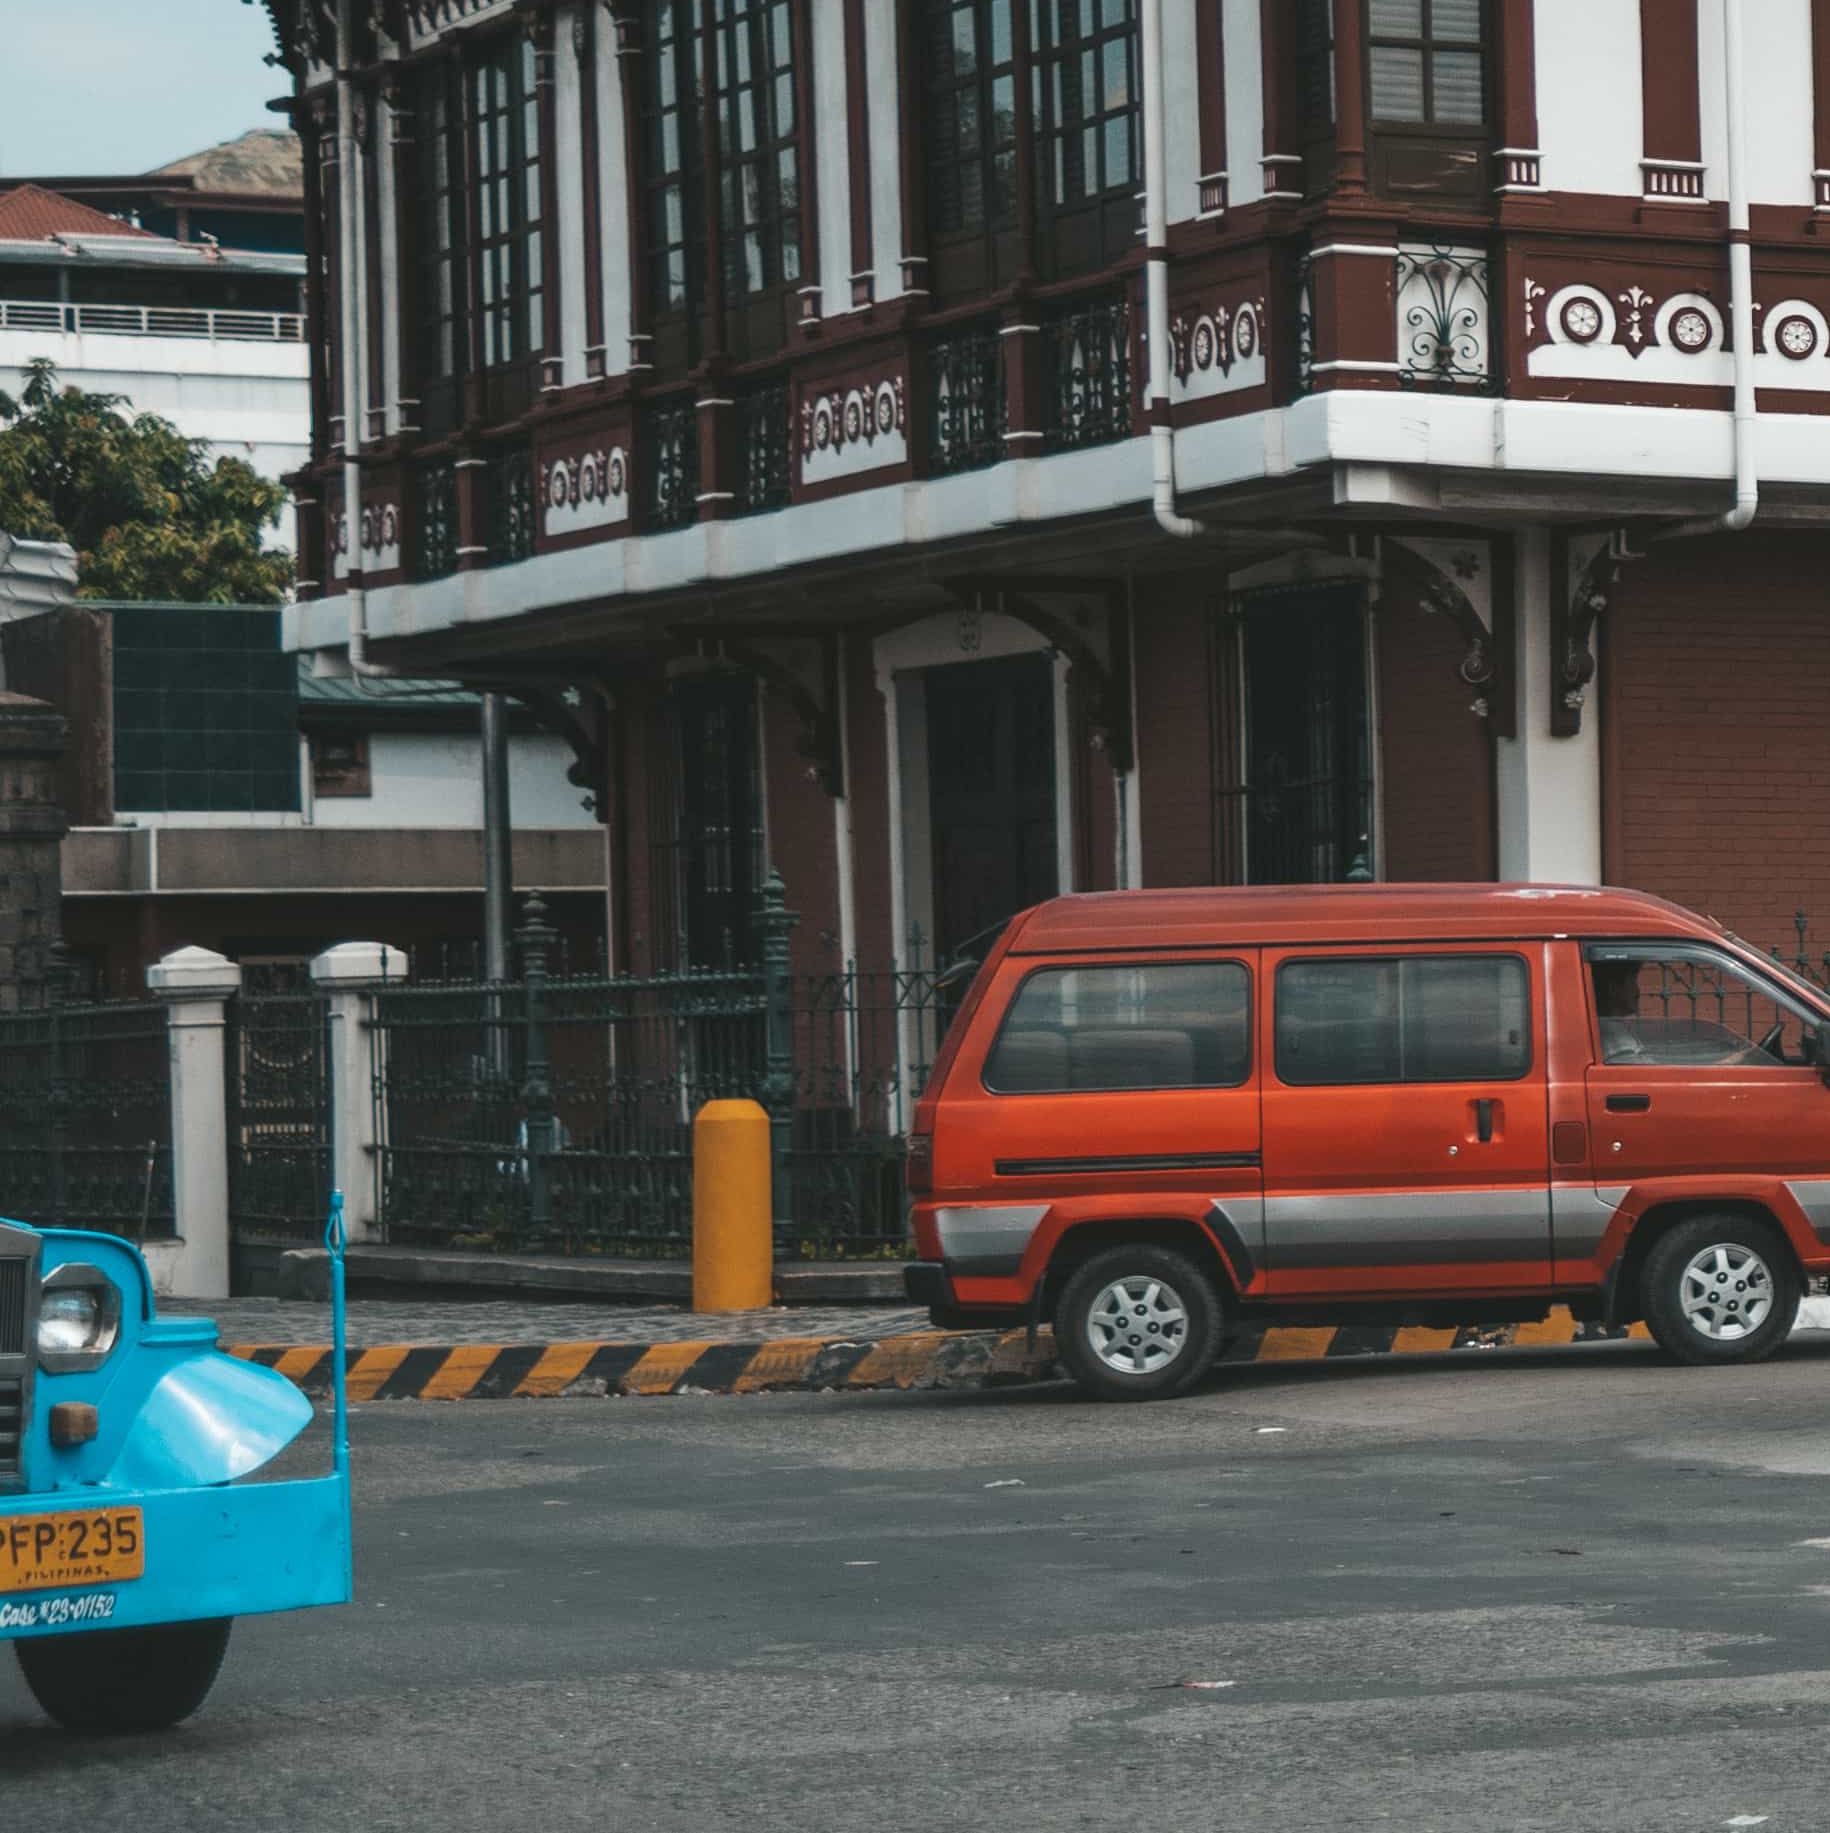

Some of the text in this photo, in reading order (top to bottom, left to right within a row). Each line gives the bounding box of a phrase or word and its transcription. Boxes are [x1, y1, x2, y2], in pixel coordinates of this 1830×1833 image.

[0, 1522, 56, 1567] FP
[67, 1515, 137, 1561] 235
[0, 1601, 38, 1628] Case
